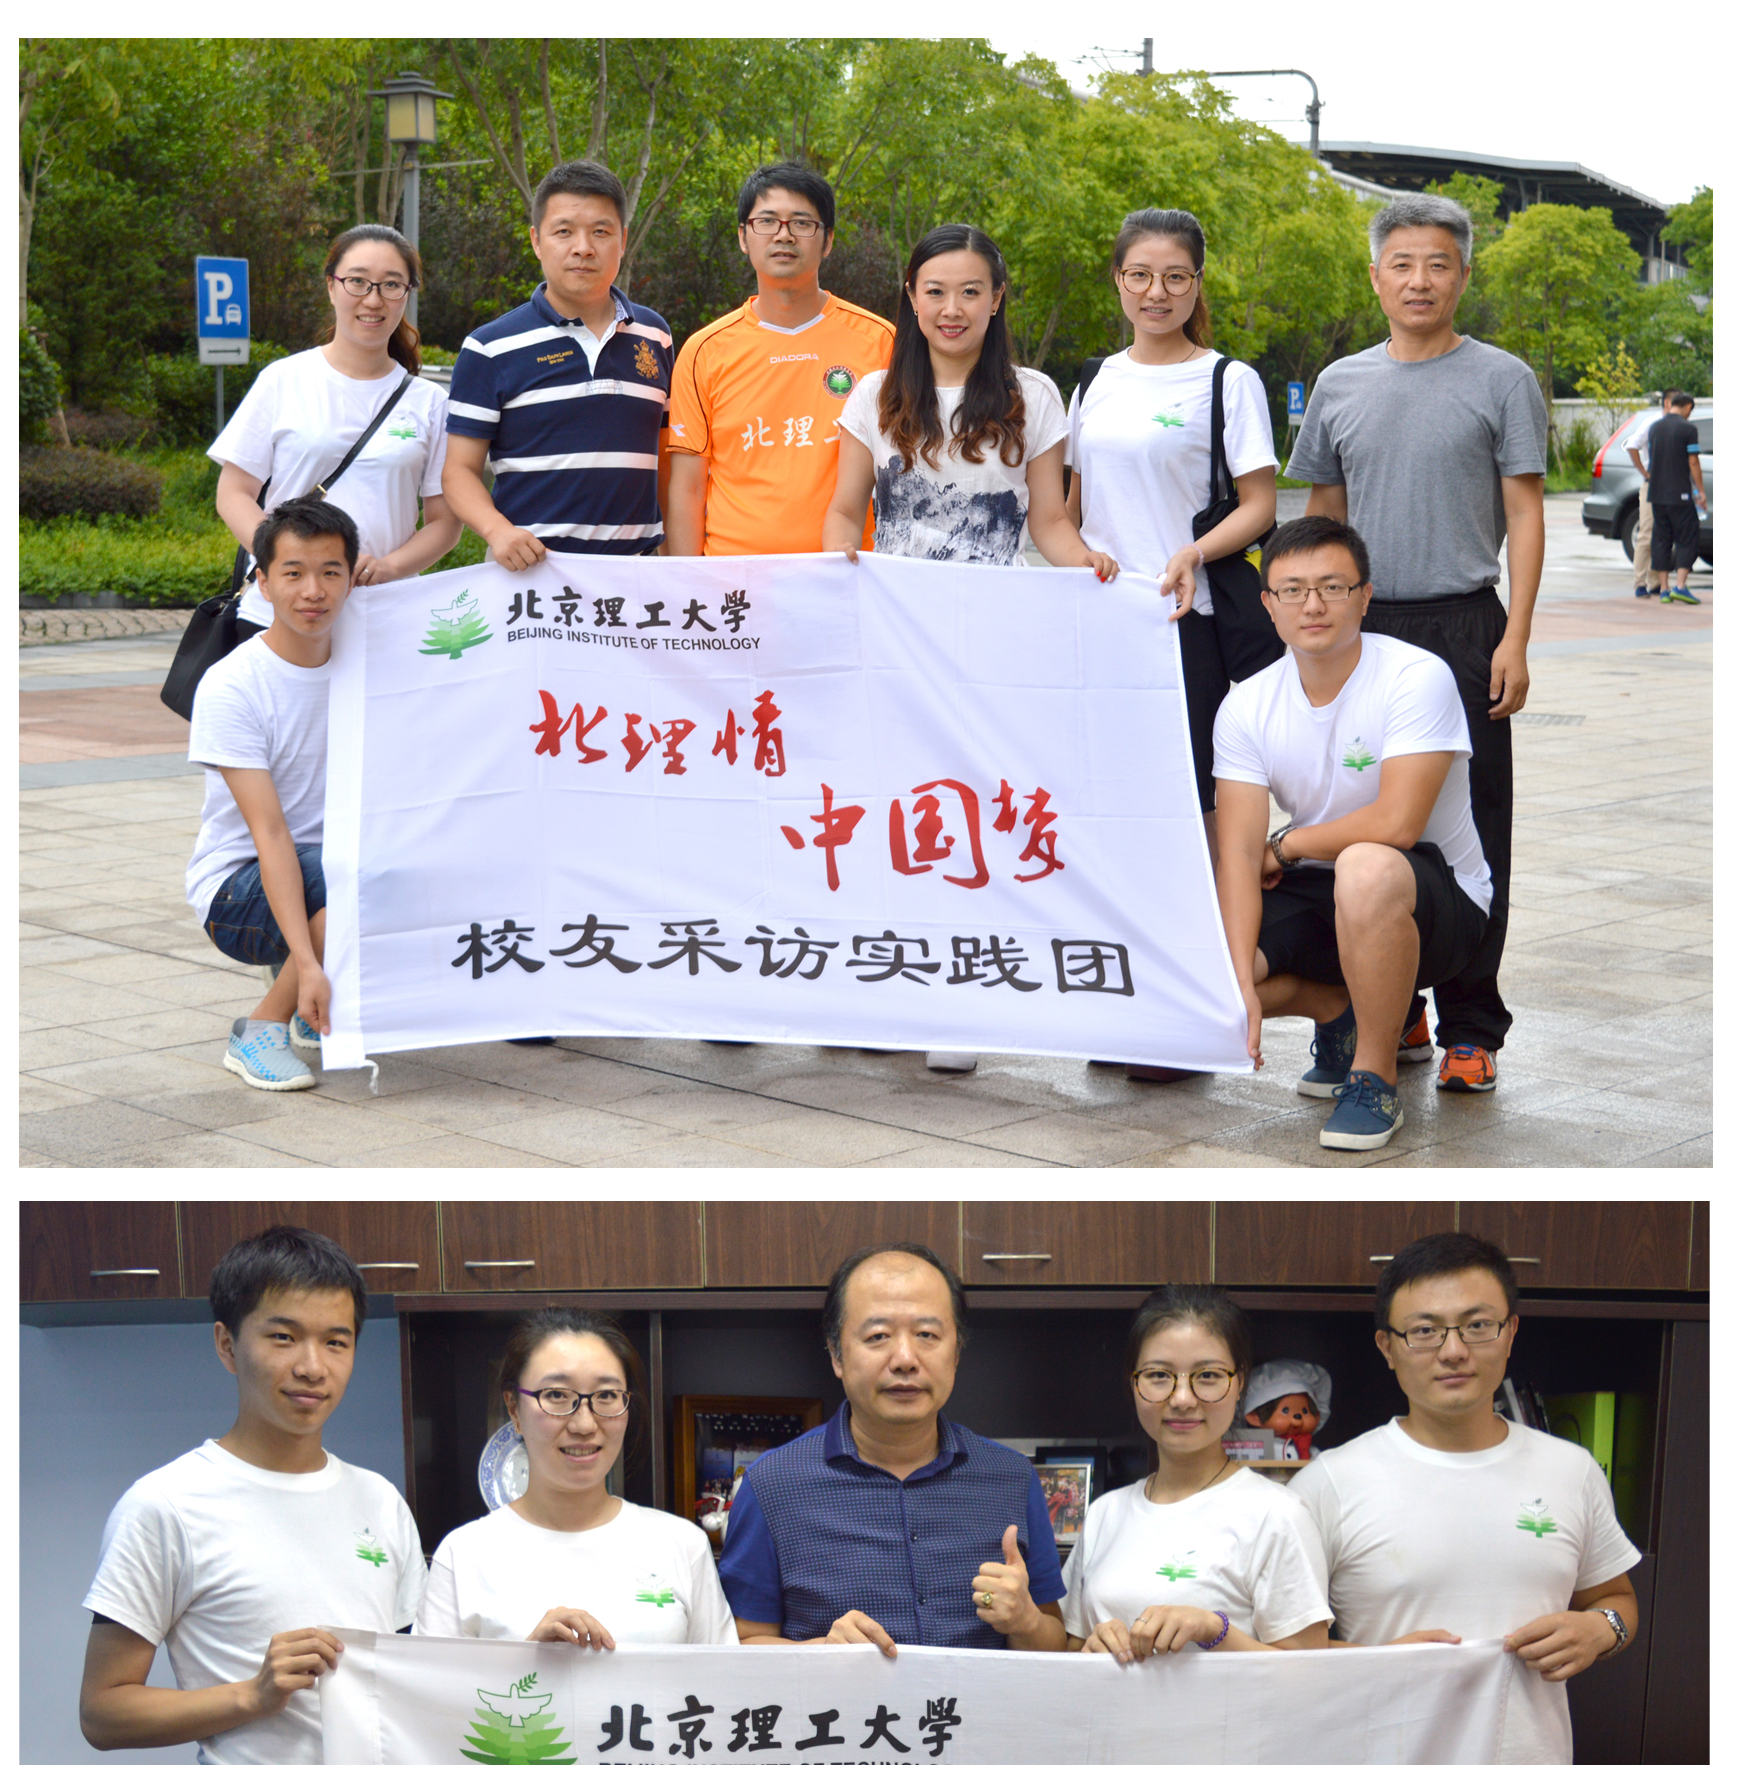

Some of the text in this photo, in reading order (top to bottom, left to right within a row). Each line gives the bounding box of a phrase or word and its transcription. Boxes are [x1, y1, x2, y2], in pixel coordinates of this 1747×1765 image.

[204, 272, 233, 325] P
[770, 353, 819, 364] DIADORA
[1290, 388, 1300, 410] P
[507, 627, 760, 650] BEIJING INSTITUTE OF TECHNOLOGY
[530, 690, 786, 776] 北理情
[781, 779, 1064, 891] 中国梦
[452, 915, 1134, 996] 校友采访实践团
